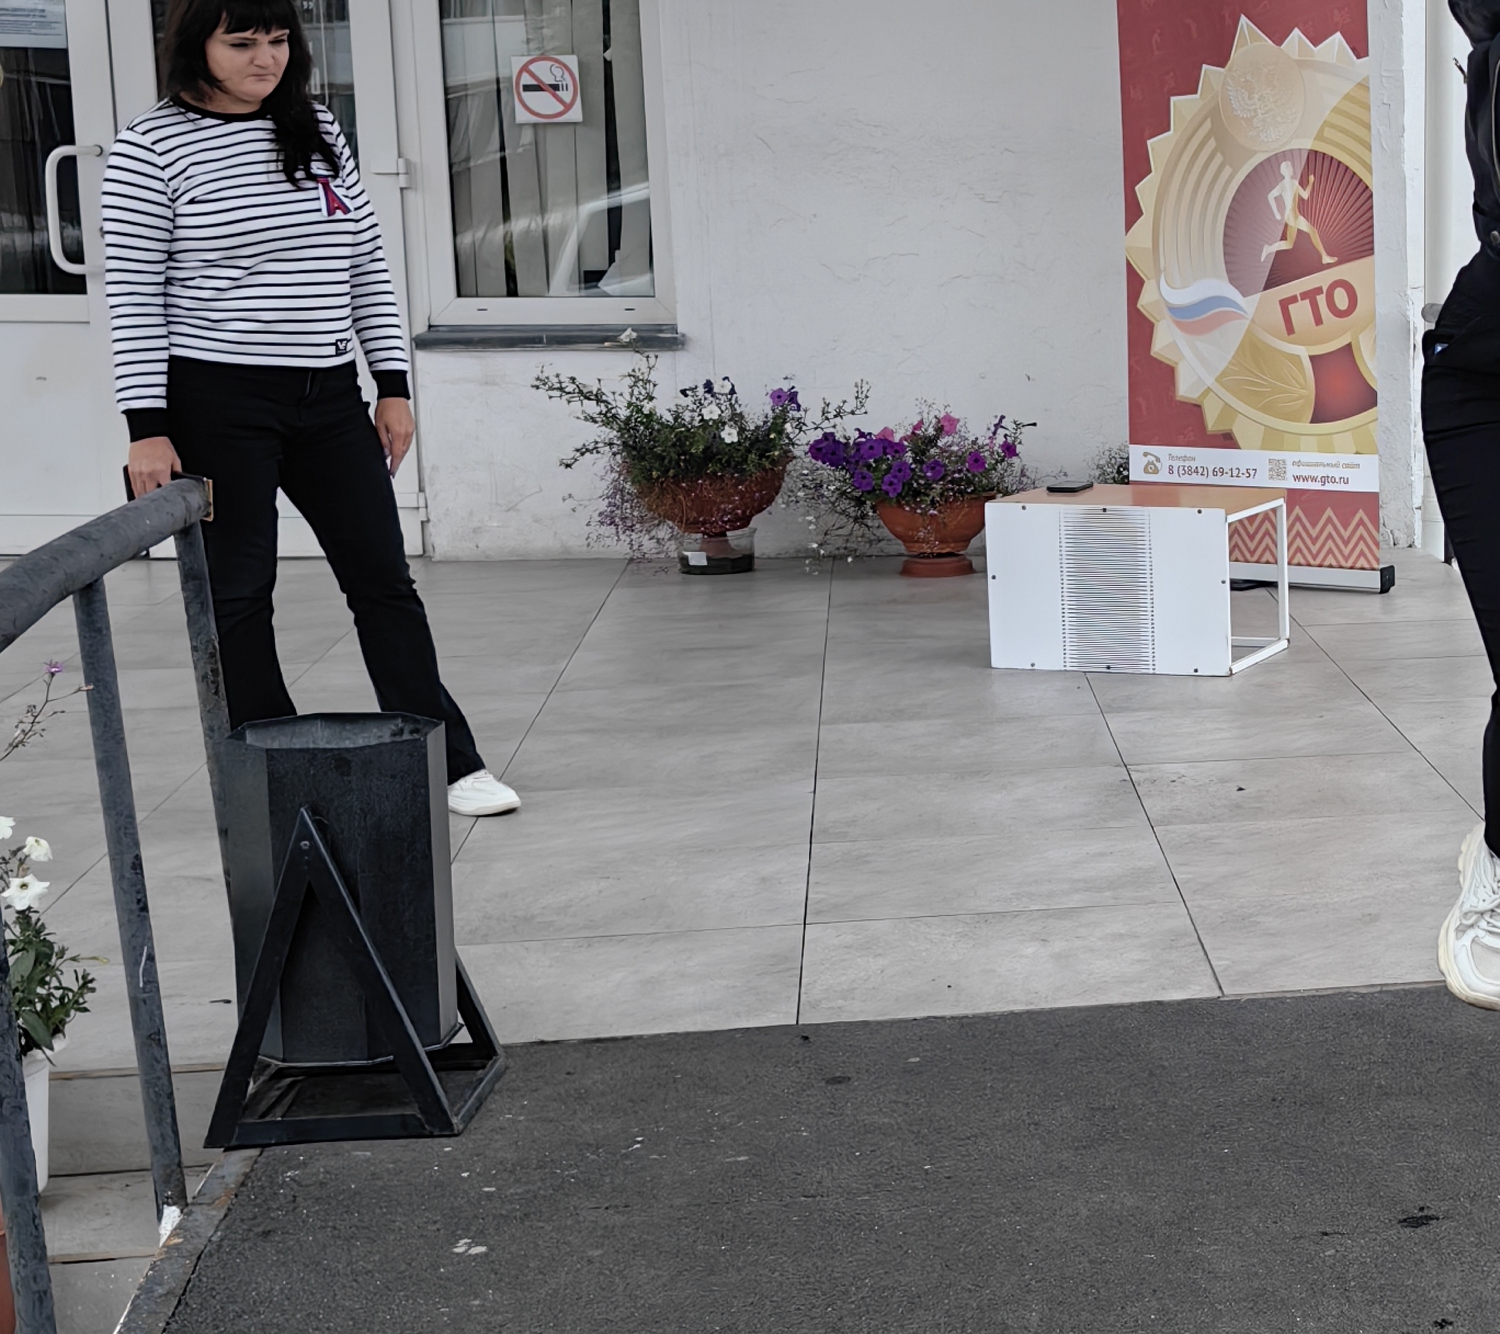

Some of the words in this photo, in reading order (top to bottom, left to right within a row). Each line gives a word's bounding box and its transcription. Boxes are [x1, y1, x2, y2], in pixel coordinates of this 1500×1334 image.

[1278, 278, 1359, 335] ГТО
[1168, 465, 1174, 475] 8
[1177, 465, 1209, 478] (3842)
[1212, 467, 1258, 479] 69-12-57
[1293, 474, 1349, 486] www.gto.ru
